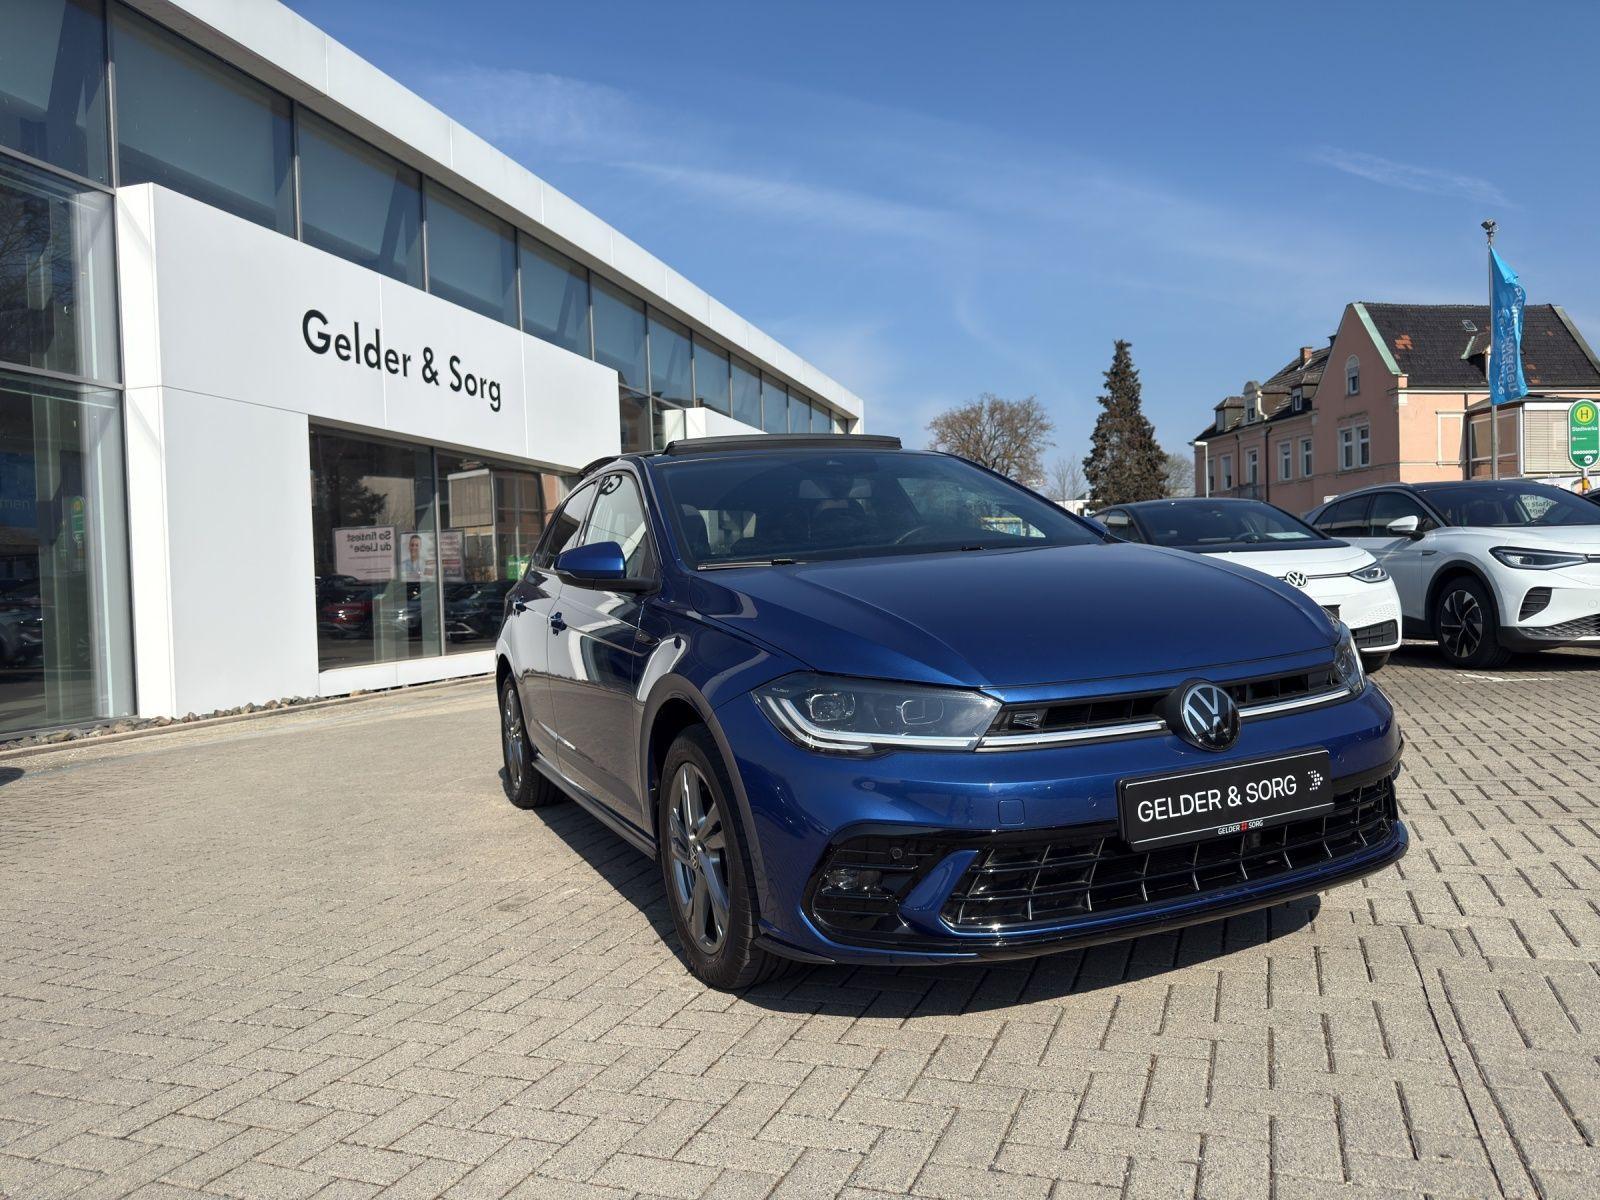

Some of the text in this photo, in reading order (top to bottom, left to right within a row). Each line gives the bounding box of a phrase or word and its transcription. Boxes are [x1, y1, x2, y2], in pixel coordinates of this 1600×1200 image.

[302, 309, 501, 412] Gelder & Sorg
[1580, 409, 1589, 419] H
[1137, 774, 1297, 822] GELDER & SORG
[1217, 819, 1264, 835] GELDER SORG
